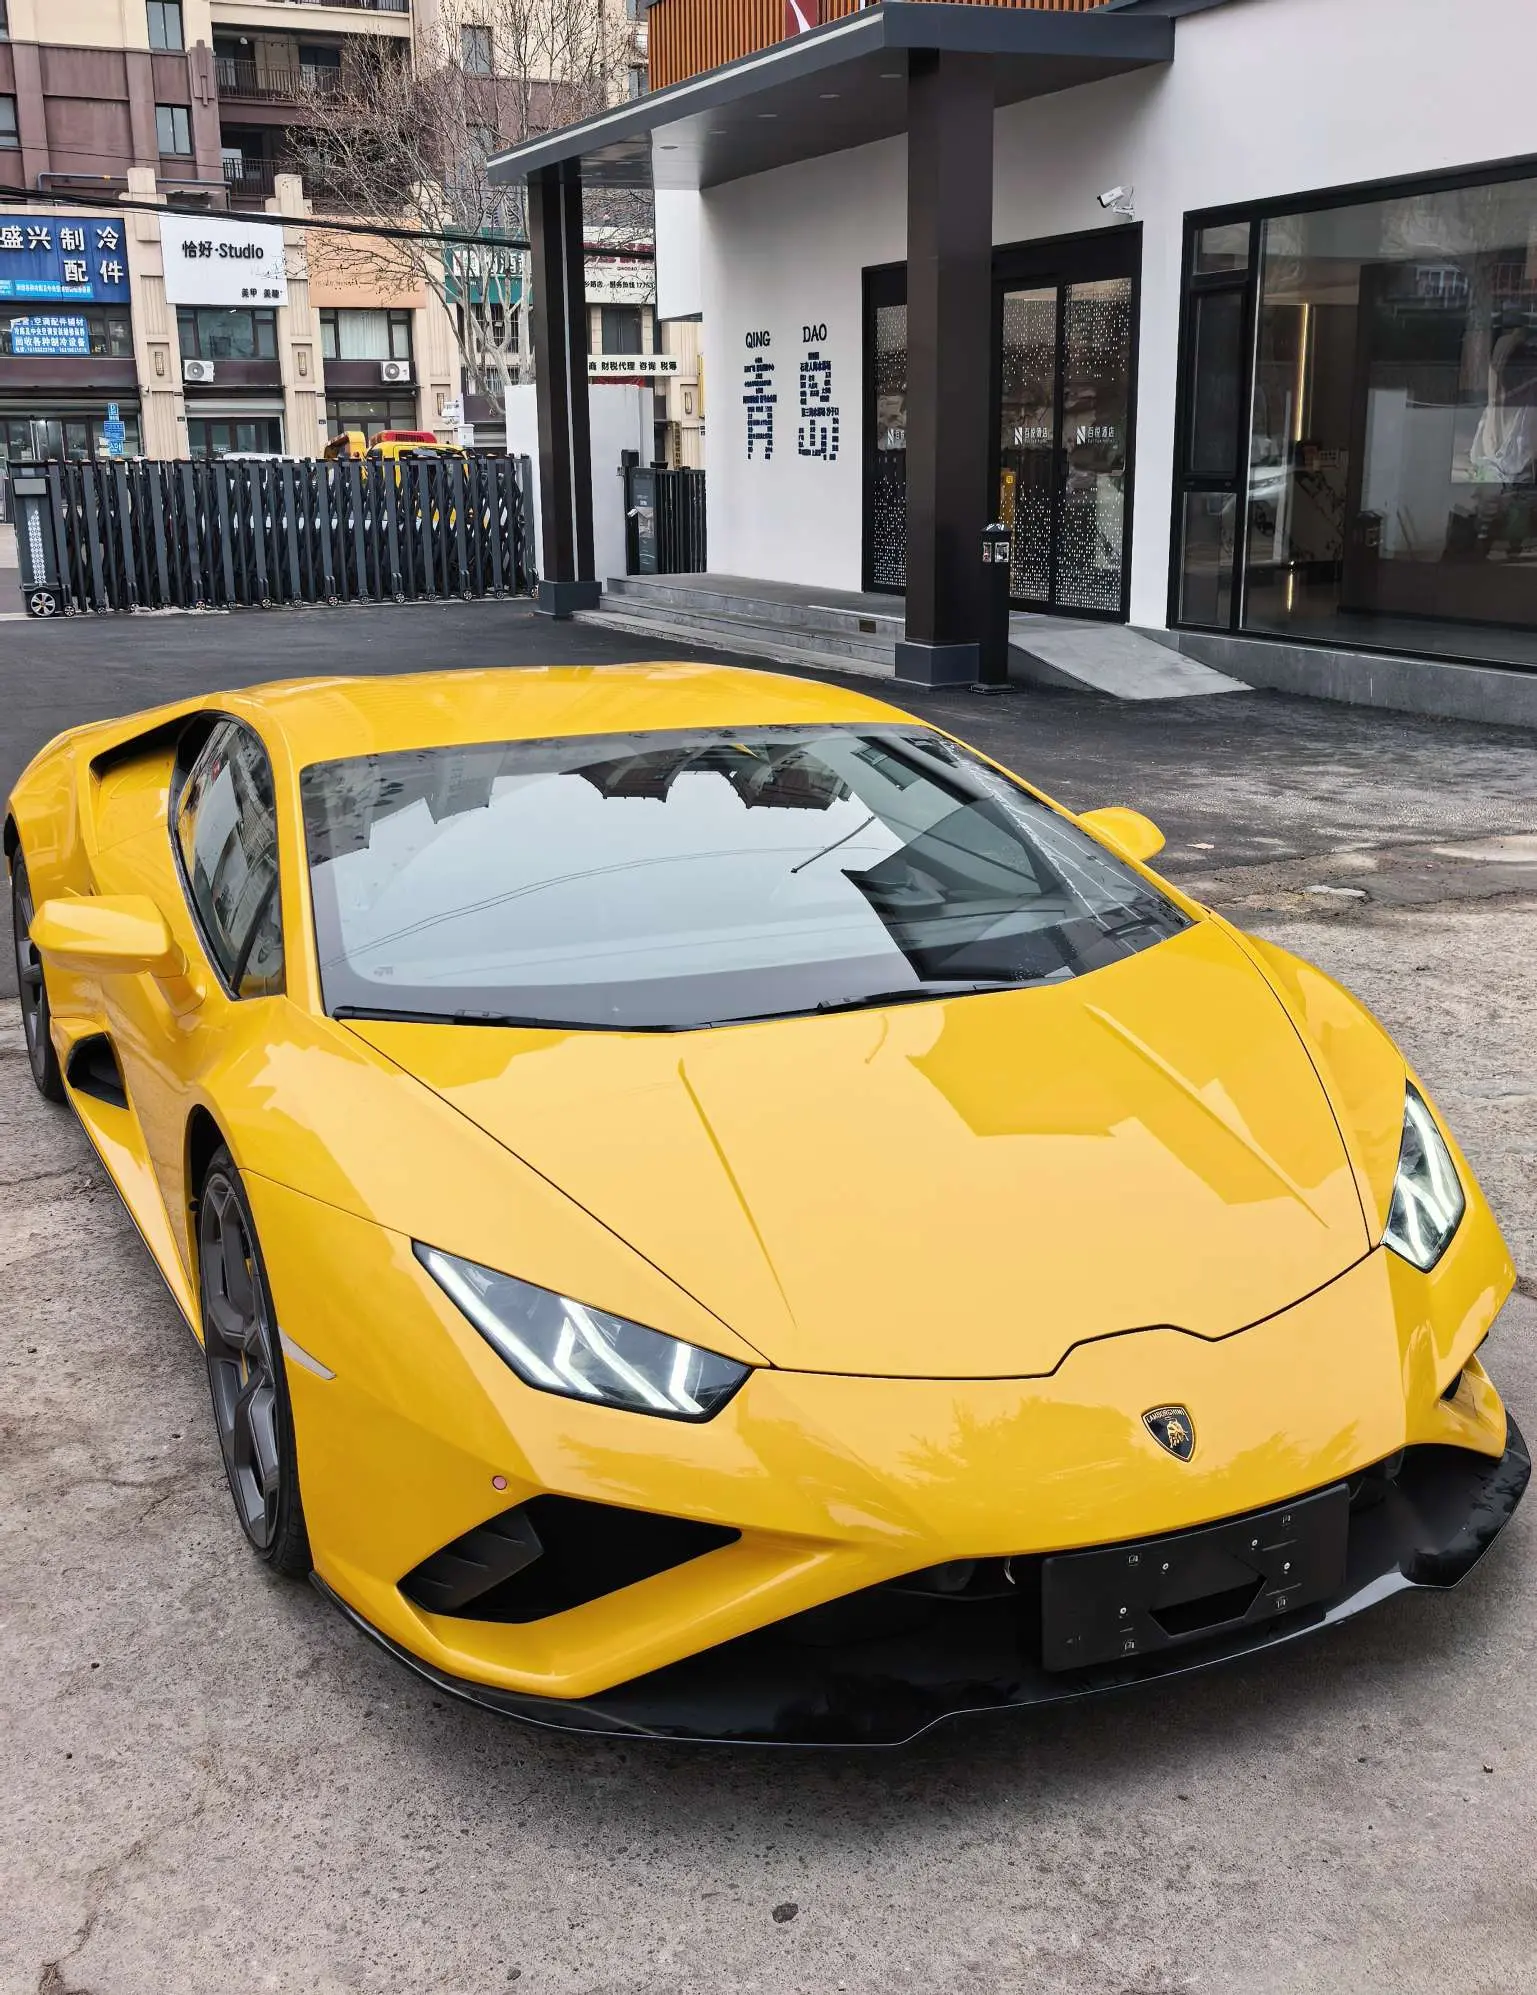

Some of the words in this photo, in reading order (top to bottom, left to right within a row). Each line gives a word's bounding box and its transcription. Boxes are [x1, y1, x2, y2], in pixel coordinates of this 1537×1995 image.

[0, 225, 119, 250] 盛兴制冷
[63, 259, 124, 283] 配件
[745, 330, 771, 348] QING
[802, 323, 827, 342] DAO
